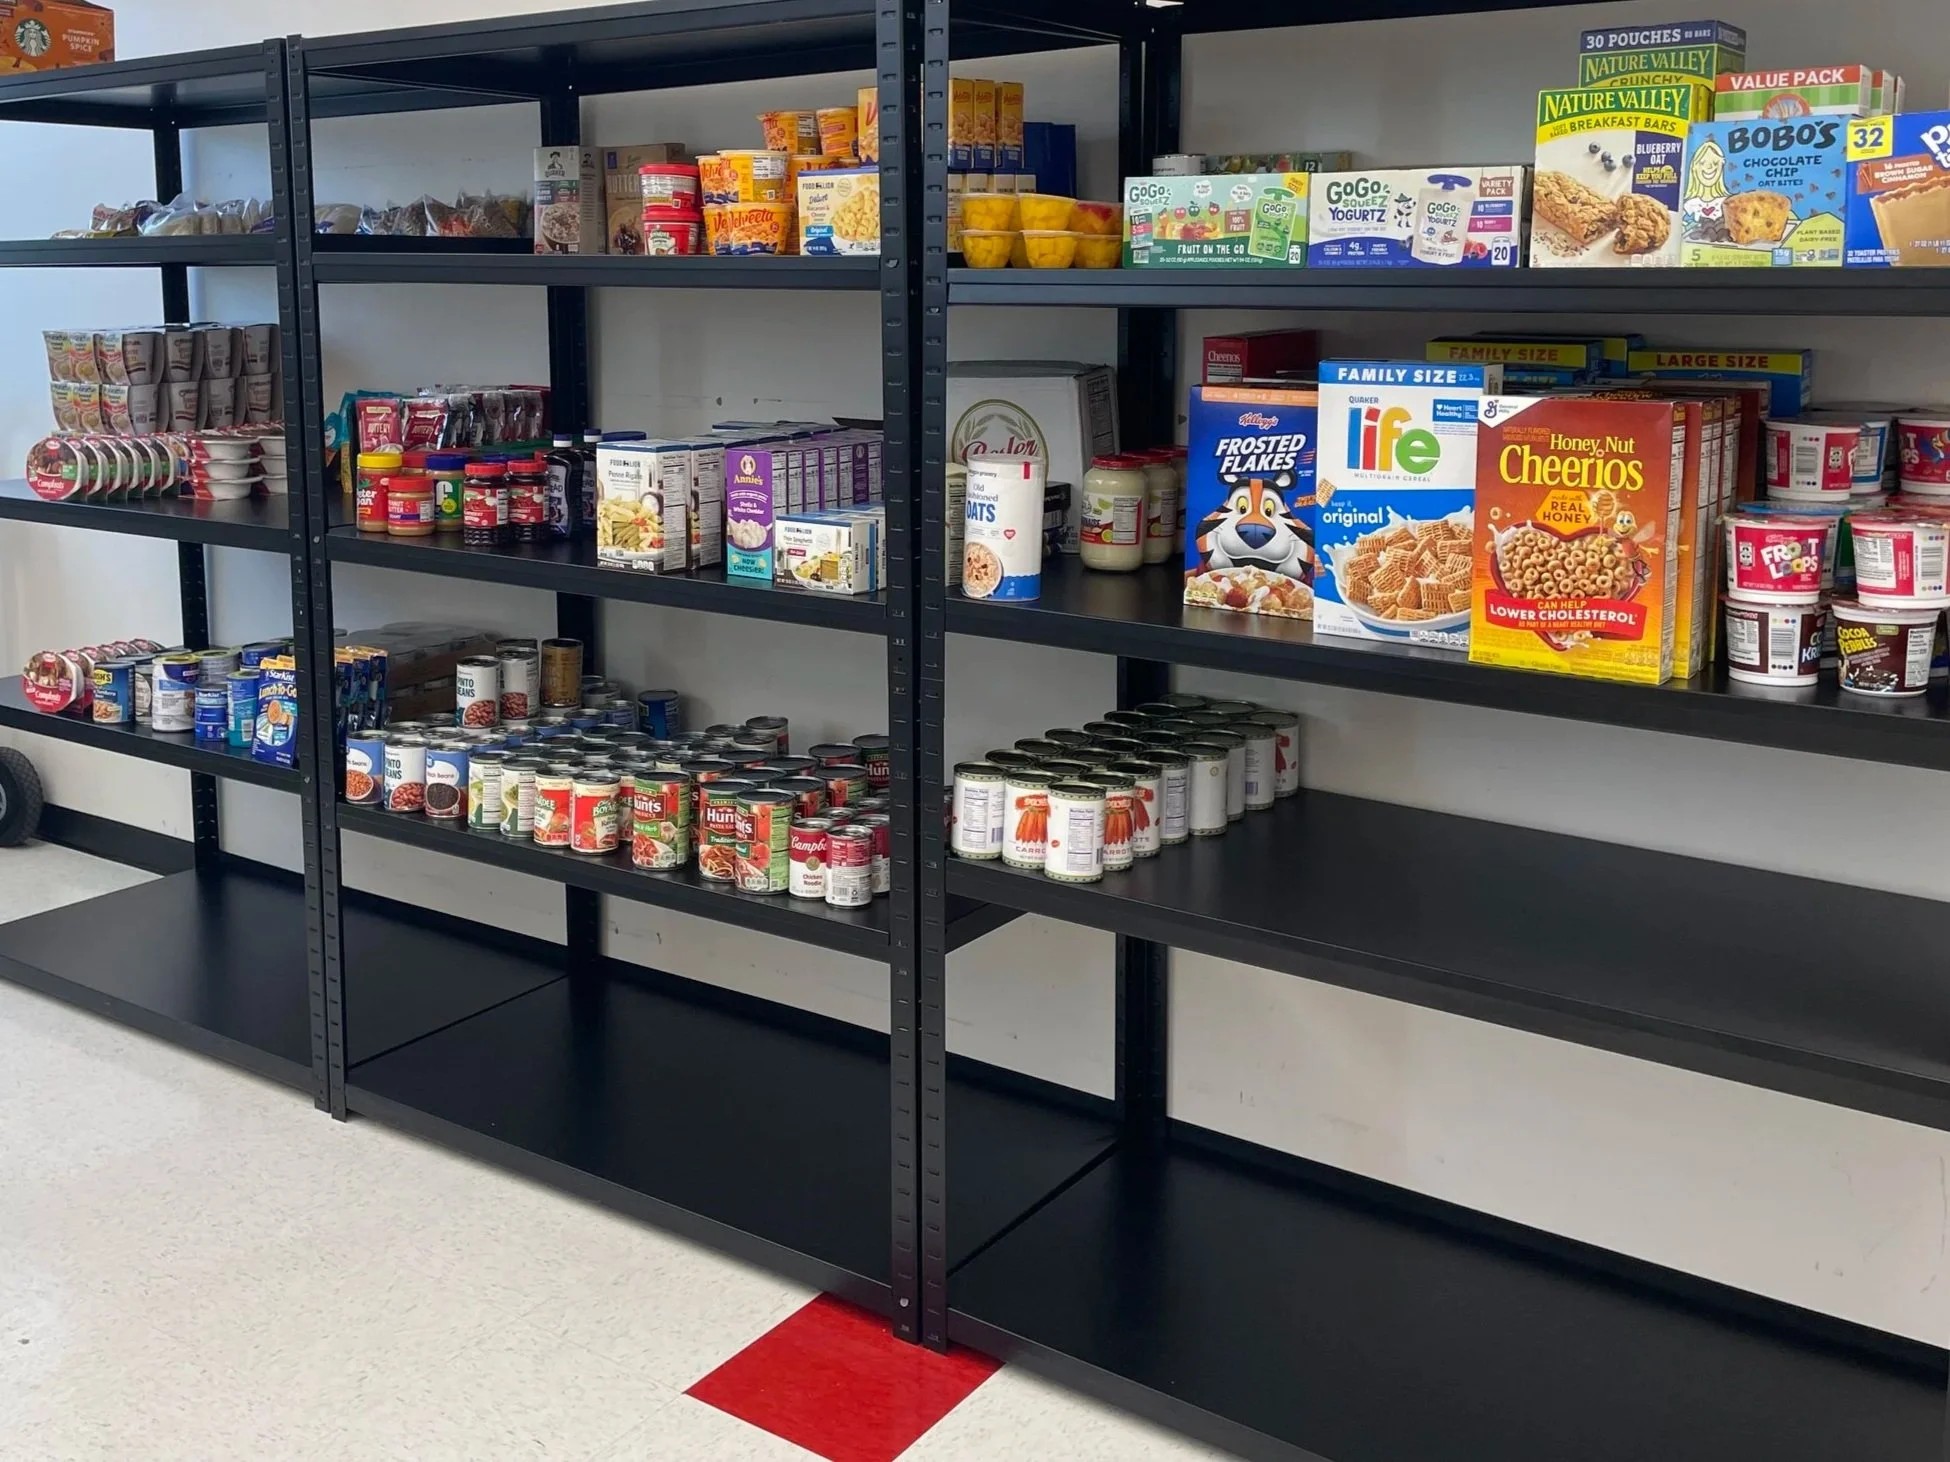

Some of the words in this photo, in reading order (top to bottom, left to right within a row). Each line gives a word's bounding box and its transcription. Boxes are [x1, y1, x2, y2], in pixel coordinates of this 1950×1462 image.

[62, 33, 100, 46] PUMPKIN
[1586, 34, 1604, 49] 30
[1608, 28, 1681, 48] POUCHES
[70, 42, 92, 52] SPICE
[1585, 54, 1648, 83] NATURE
[1650, 50, 1711, 74] VALLEY
[1730, 73, 1789, 90] VALUE
[1793, 68, 1845, 86] PACK
[1543, 91, 1616, 123] NATURE
[1618, 88, 1686, 117] VALLEY
[1569, 116, 1641, 133] BREAKFAST
[1643, 117, 1677, 133] BARS
[1728, 120, 1841, 154] BOBO'S
[1853, 127, 1884, 148] 32
[1636, 142, 1682, 155] BLUEBERRY
[1650, 154, 1666, 165] OAT
[1743, 155, 1822, 168] CHOCOLATE
[1305, 161, 1316, 172] 12
[1765, 167, 1799, 178] CHIP
[1873, 168, 1904, 179] BROWN
[1906, 164, 1934, 175] SUGAR
[1481, 179, 1512, 188] VARIETY
[1758, 179, 1776, 188] OAT
[1777, 179, 1803, 187] BITES
[1881, 172, 1927, 184] CINNAMON
[1129, 183, 1166, 203] GoGo
[1326, 177, 1382, 205] GoGo
[1486, 187, 1506, 196] PACK
[1262, 203, 1287, 214] GoGo
[1328, 206, 1386, 223] YOGURTZ
[1427, 202, 1457, 214] GoGo
[1427, 216, 1457, 227] YOGURTZ
[1177, 244, 1201, 254] FRUIT
[1203, 244, 1214, 254] ON
[1216, 244, 1230, 254] THE
[1233, 244, 1245, 254] GO
[1494, 246, 1508, 261] 20
[1691, 249, 1701, 261] 5
[1290, 251, 1300, 261] 20
[1208, 350, 1241, 363] Cheerios
[1449, 346, 1511, 361] FAMILY
[1517, 348, 1559, 362] SIZE
[1656, 354, 1719, 368] LARGE
[1726, 355, 1769, 369] SIZE
[1338, 367, 1408, 383] FAMILY
[1413, 370, 1457, 384] SIZE
[1348, 396, 1379, 404] QUAKER
[1239, 412, 1279, 430] Kellogg's
[1436, 410, 1462, 419] Healthy
[1215, 433, 1307, 457] FROSTED
[1347, 406, 1441, 475] life
[1550, 433, 1600, 457] Honey
[1605, 436, 1635, 454] Nut
[1220, 452, 1298, 474] FLAKES
[1500, 444, 1644, 491] Cheerios
[733, 474, 764, 486] Annie's
[966, 500, 996, 523] OATS
[1551, 501, 1585, 513] REAL
[1322, 507, 1383, 527] original
[1543, 511, 1592, 524] HONEY
[742, 558, 757, 566] NOW
[1769, 556, 1819, 580] LOOPS
[1537, 601, 1559, 610] CAN
[1560, 600, 1588, 610] HELP
[1490, 603, 1536, 621] LOWER
[1538, 609, 1637, 626] CHOLESTEROL
[1837, 626, 1871, 639] COCOA
[1837, 637, 1878, 656] PEBBLES
[270, 669, 296, 682] StarKist
[866, 764, 889, 776] Hun
[634, 794, 662, 813] unt's
[707, 808, 736, 823] Hun
[1015, 846, 1046, 854] CARRO
